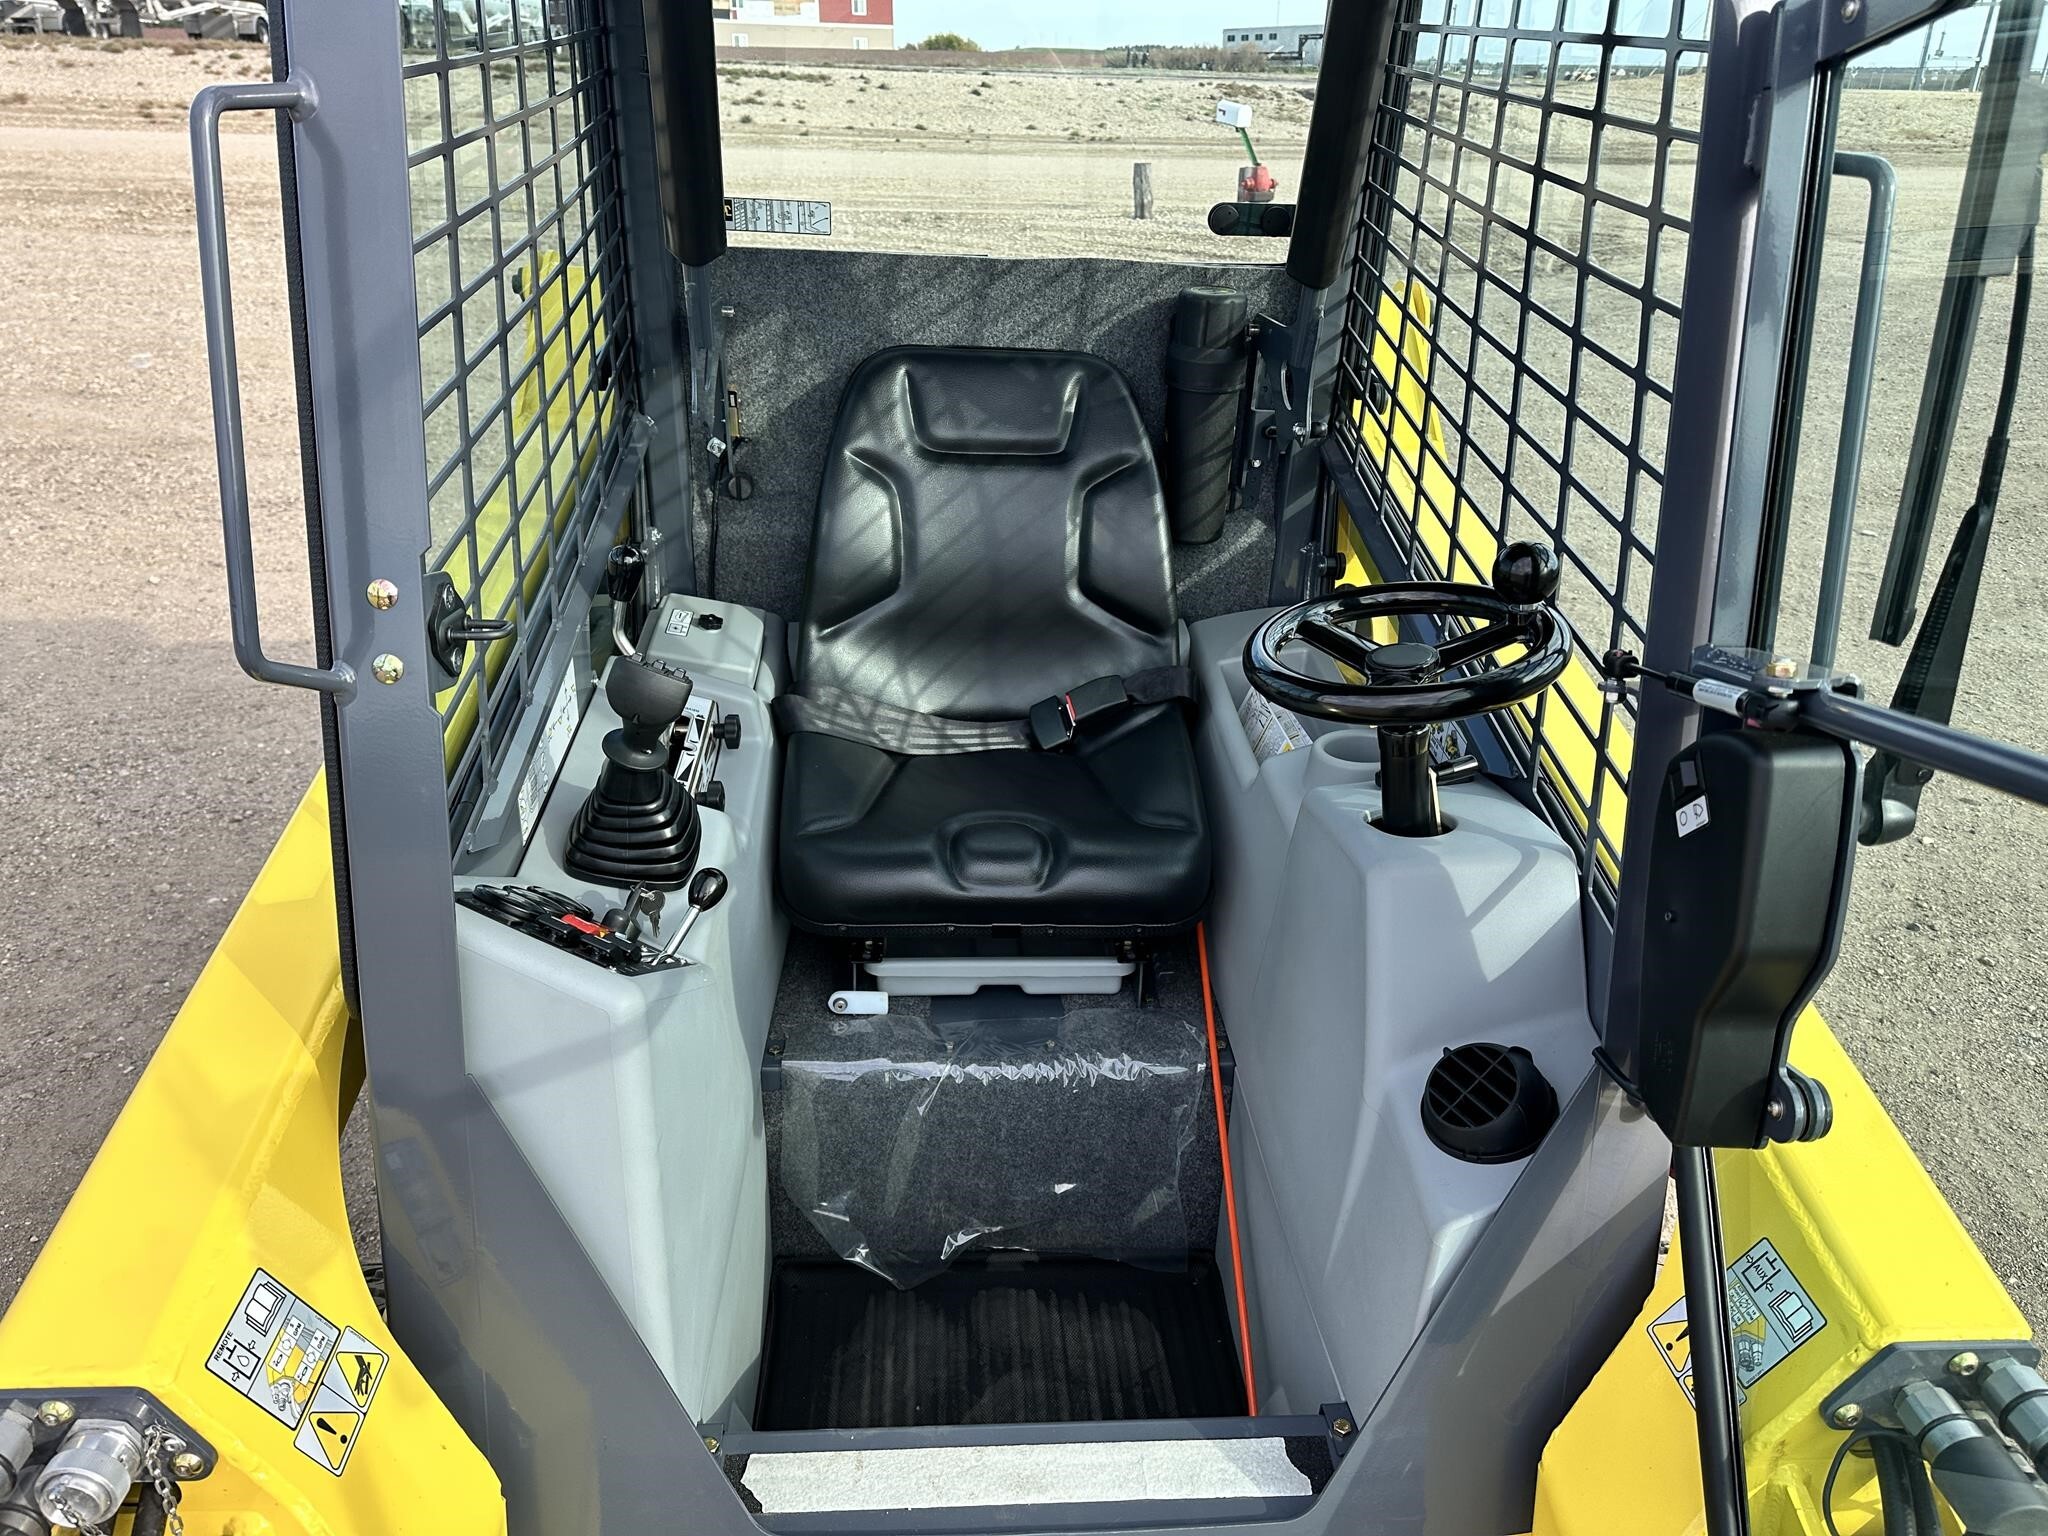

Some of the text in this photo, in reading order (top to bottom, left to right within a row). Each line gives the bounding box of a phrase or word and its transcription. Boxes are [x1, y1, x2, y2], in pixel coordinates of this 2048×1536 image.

[1753, 1264, 1768, 1281] AUX
[293, 1322, 302, 1337] GPM
[213, 1330, 234, 1361] REMOTE
[316, 1335, 326, 1349] GPM
